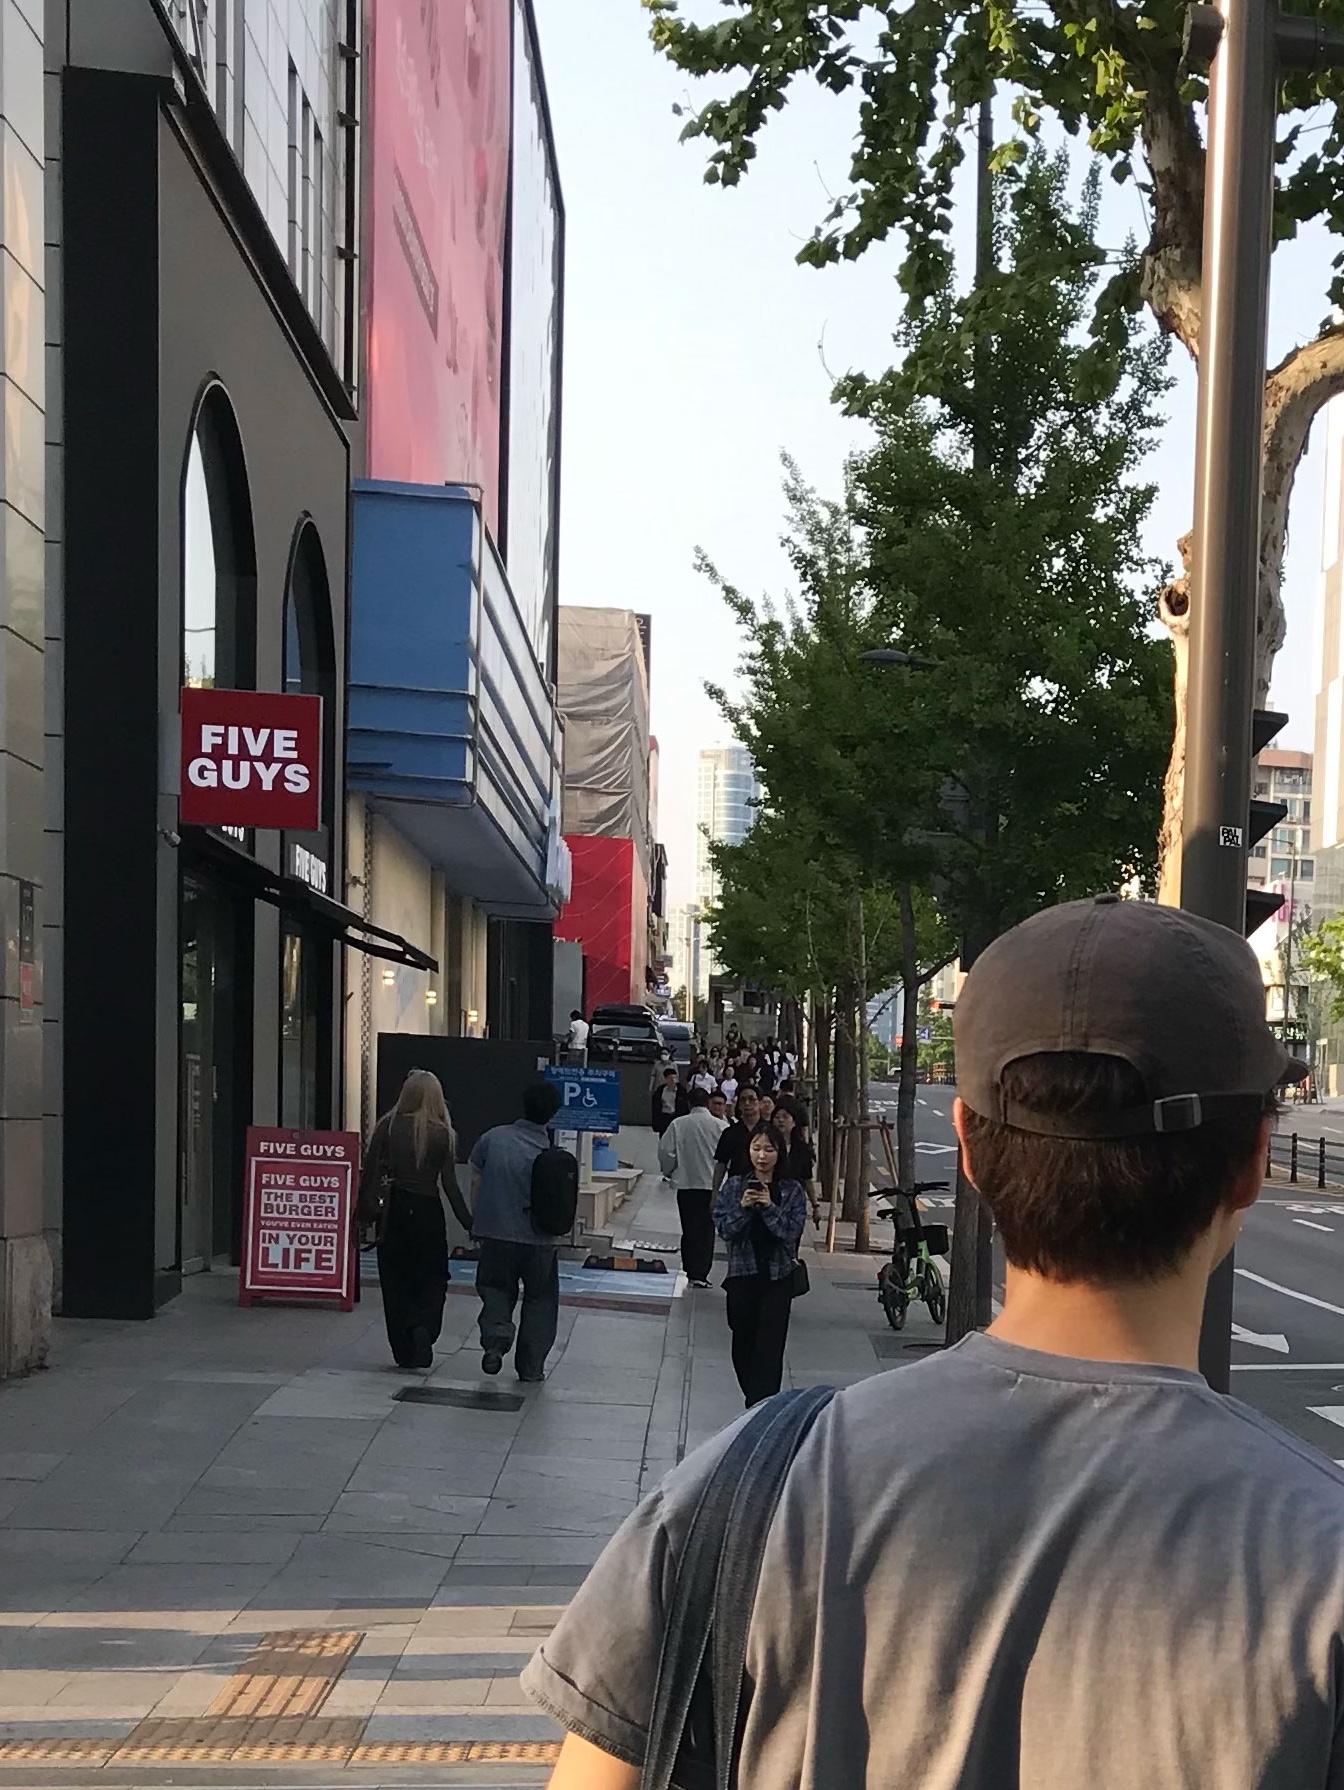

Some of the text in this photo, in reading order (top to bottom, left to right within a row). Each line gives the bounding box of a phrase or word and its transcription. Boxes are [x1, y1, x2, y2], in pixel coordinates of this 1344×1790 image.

[201, 724, 298, 759] FIVE
[188, 757, 310, 794] GUYS
[295, 844, 327, 893] FIVE GUYS
[564, 1081, 582, 1106] P
[259, 1141, 346, 1158] FIVE GUYS
[261, 1173, 340, 1188] FIVE GUYS
[264, 1191, 336, 1205] THE BEST
[263, 1203, 336, 1218] BURGER
[261, 1220, 290, 1228] YOU'VE
[313, 1222, 338, 1230] EATEN
[261, 1232, 335, 1247] IN YOUR
[260, 1246, 334, 1271] LIFE
